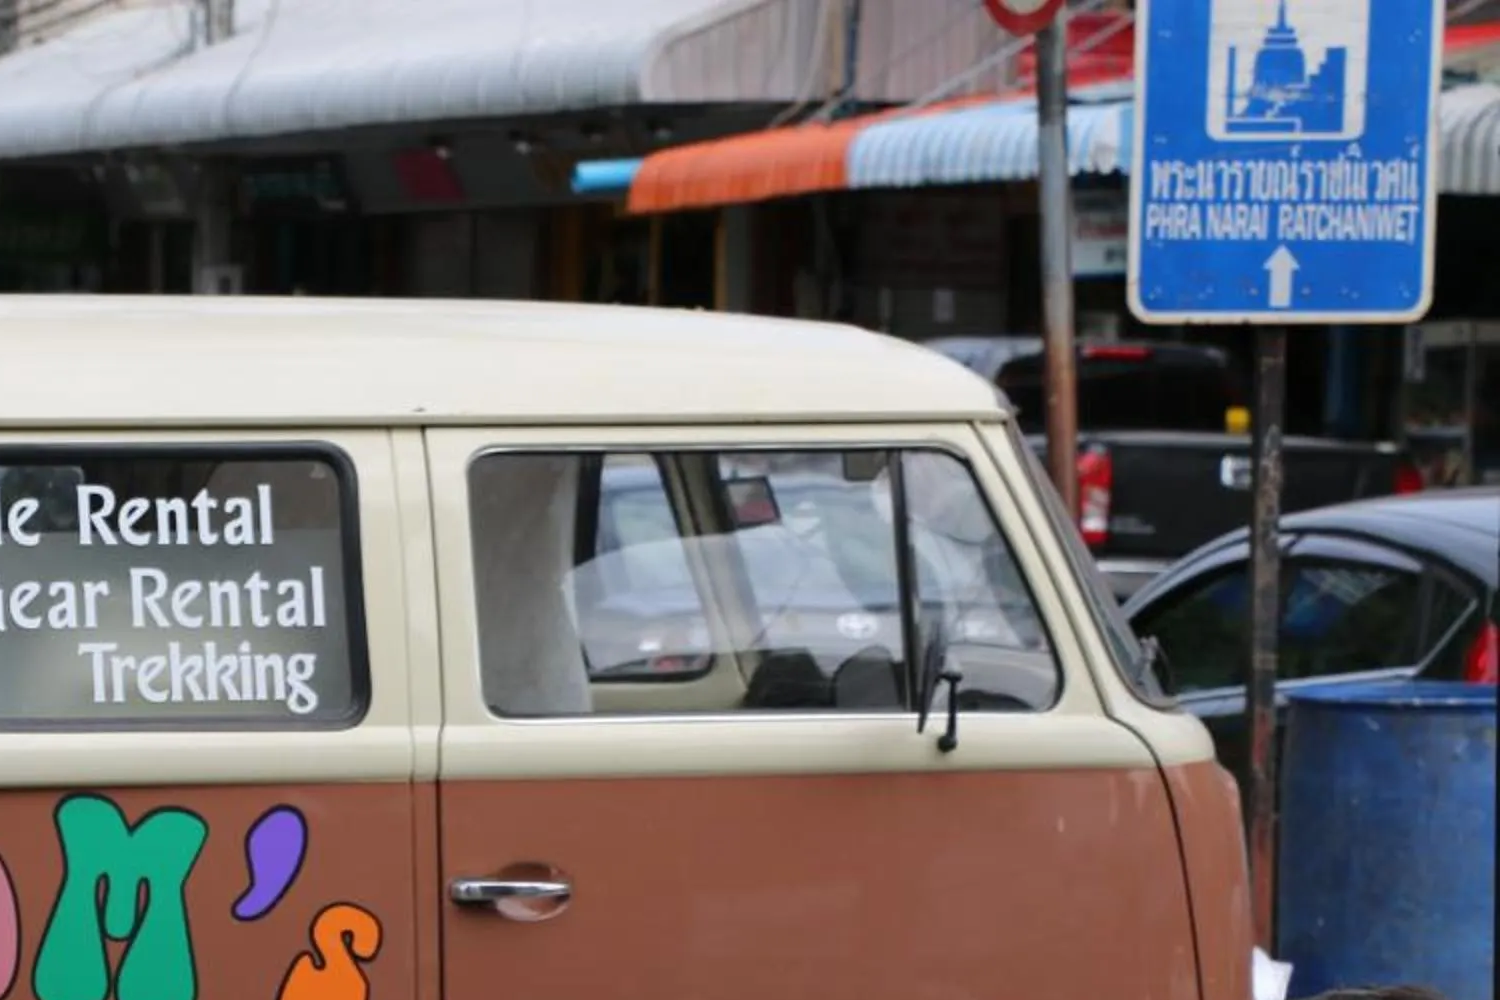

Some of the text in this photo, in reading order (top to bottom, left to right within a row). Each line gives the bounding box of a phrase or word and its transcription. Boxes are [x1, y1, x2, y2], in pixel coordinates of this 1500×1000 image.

[1146, 203, 1201, 241] PHRA
[1206, 203, 1270, 241] NARAI
[1277, 204, 1420, 244] RATCHANIWET
[77, 484, 274, 547] Rental
[129, 566, 326, 629] Rental
[78, 641, 317, 714] Trekking
